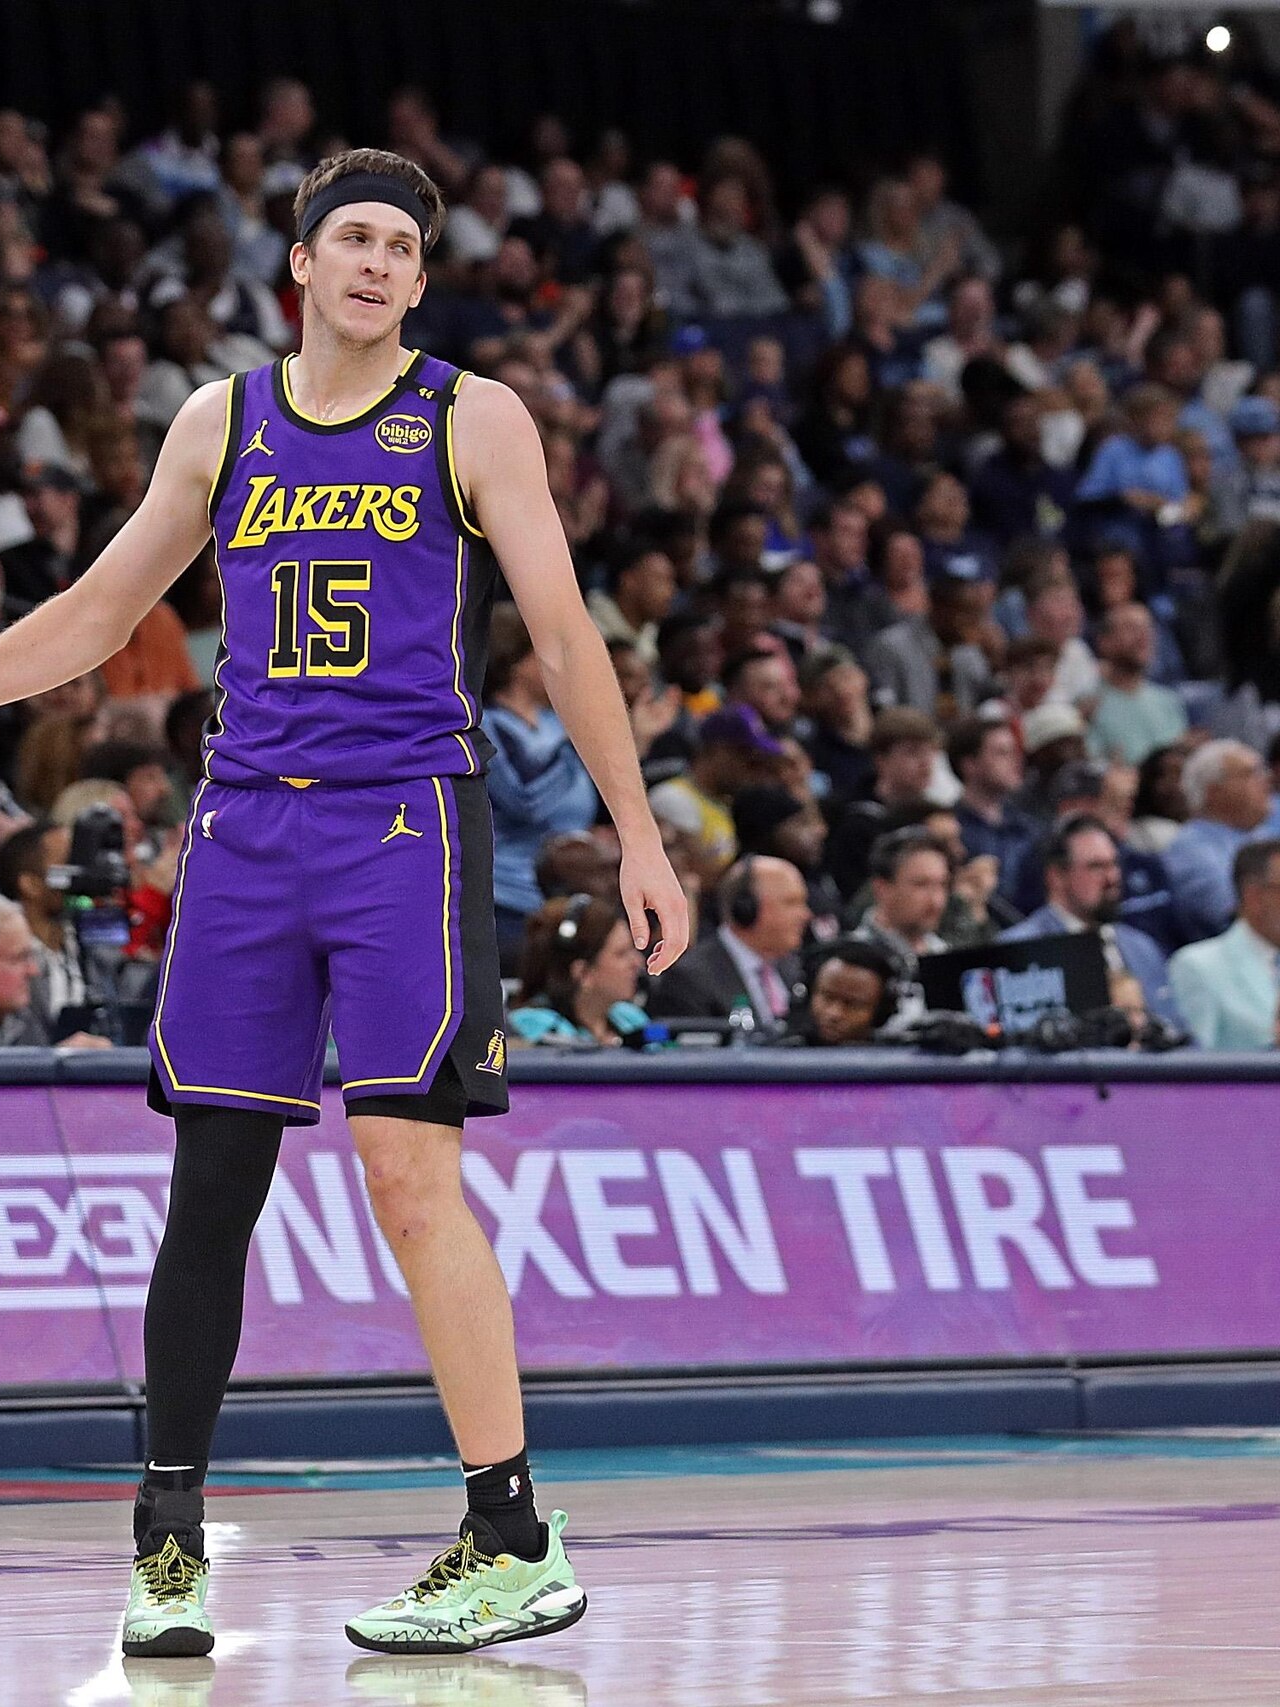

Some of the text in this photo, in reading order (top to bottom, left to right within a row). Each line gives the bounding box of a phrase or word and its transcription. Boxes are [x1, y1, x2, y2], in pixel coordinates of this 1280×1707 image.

[381, 423, 429, 443] bibigo
[227, 475, 422, 549] LAKERS
[267, 560, 371, 679] 15
[253, 1145, 1160, 1305] NXEN TIRE
